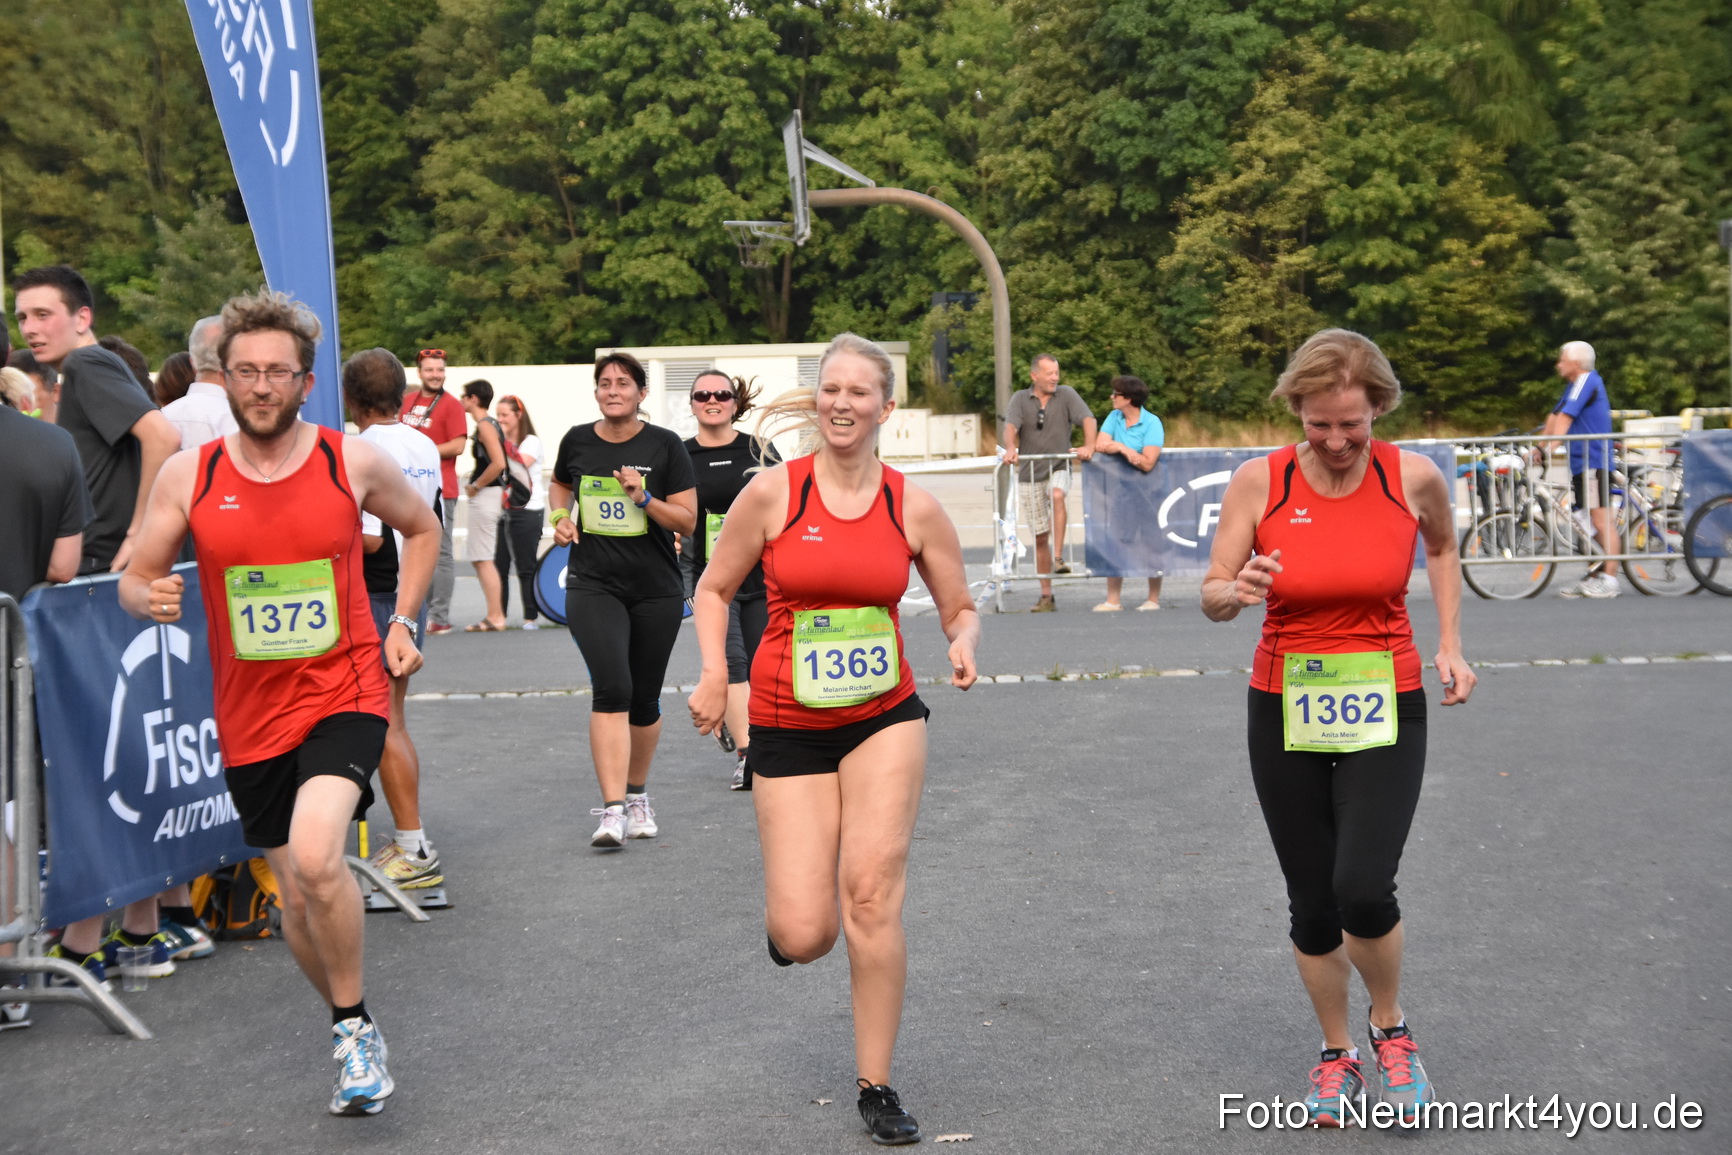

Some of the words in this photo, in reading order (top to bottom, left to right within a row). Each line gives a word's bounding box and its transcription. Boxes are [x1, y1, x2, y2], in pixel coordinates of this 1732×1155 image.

[599, 501, 625, 520] 98
[1197, 503, 1224, 537] F
[1290, 516, 1312, 524] erima
[240, 600, 327, 634] 1373
[807, 626, 845, 634] firmenlauf
[804, 645, 889, 681] 1363
[1299, 669, 1338, 678] firmenlauf
[1295, 692, 1385, 725] 1362
[143, 707, 225, 795] Fisc
